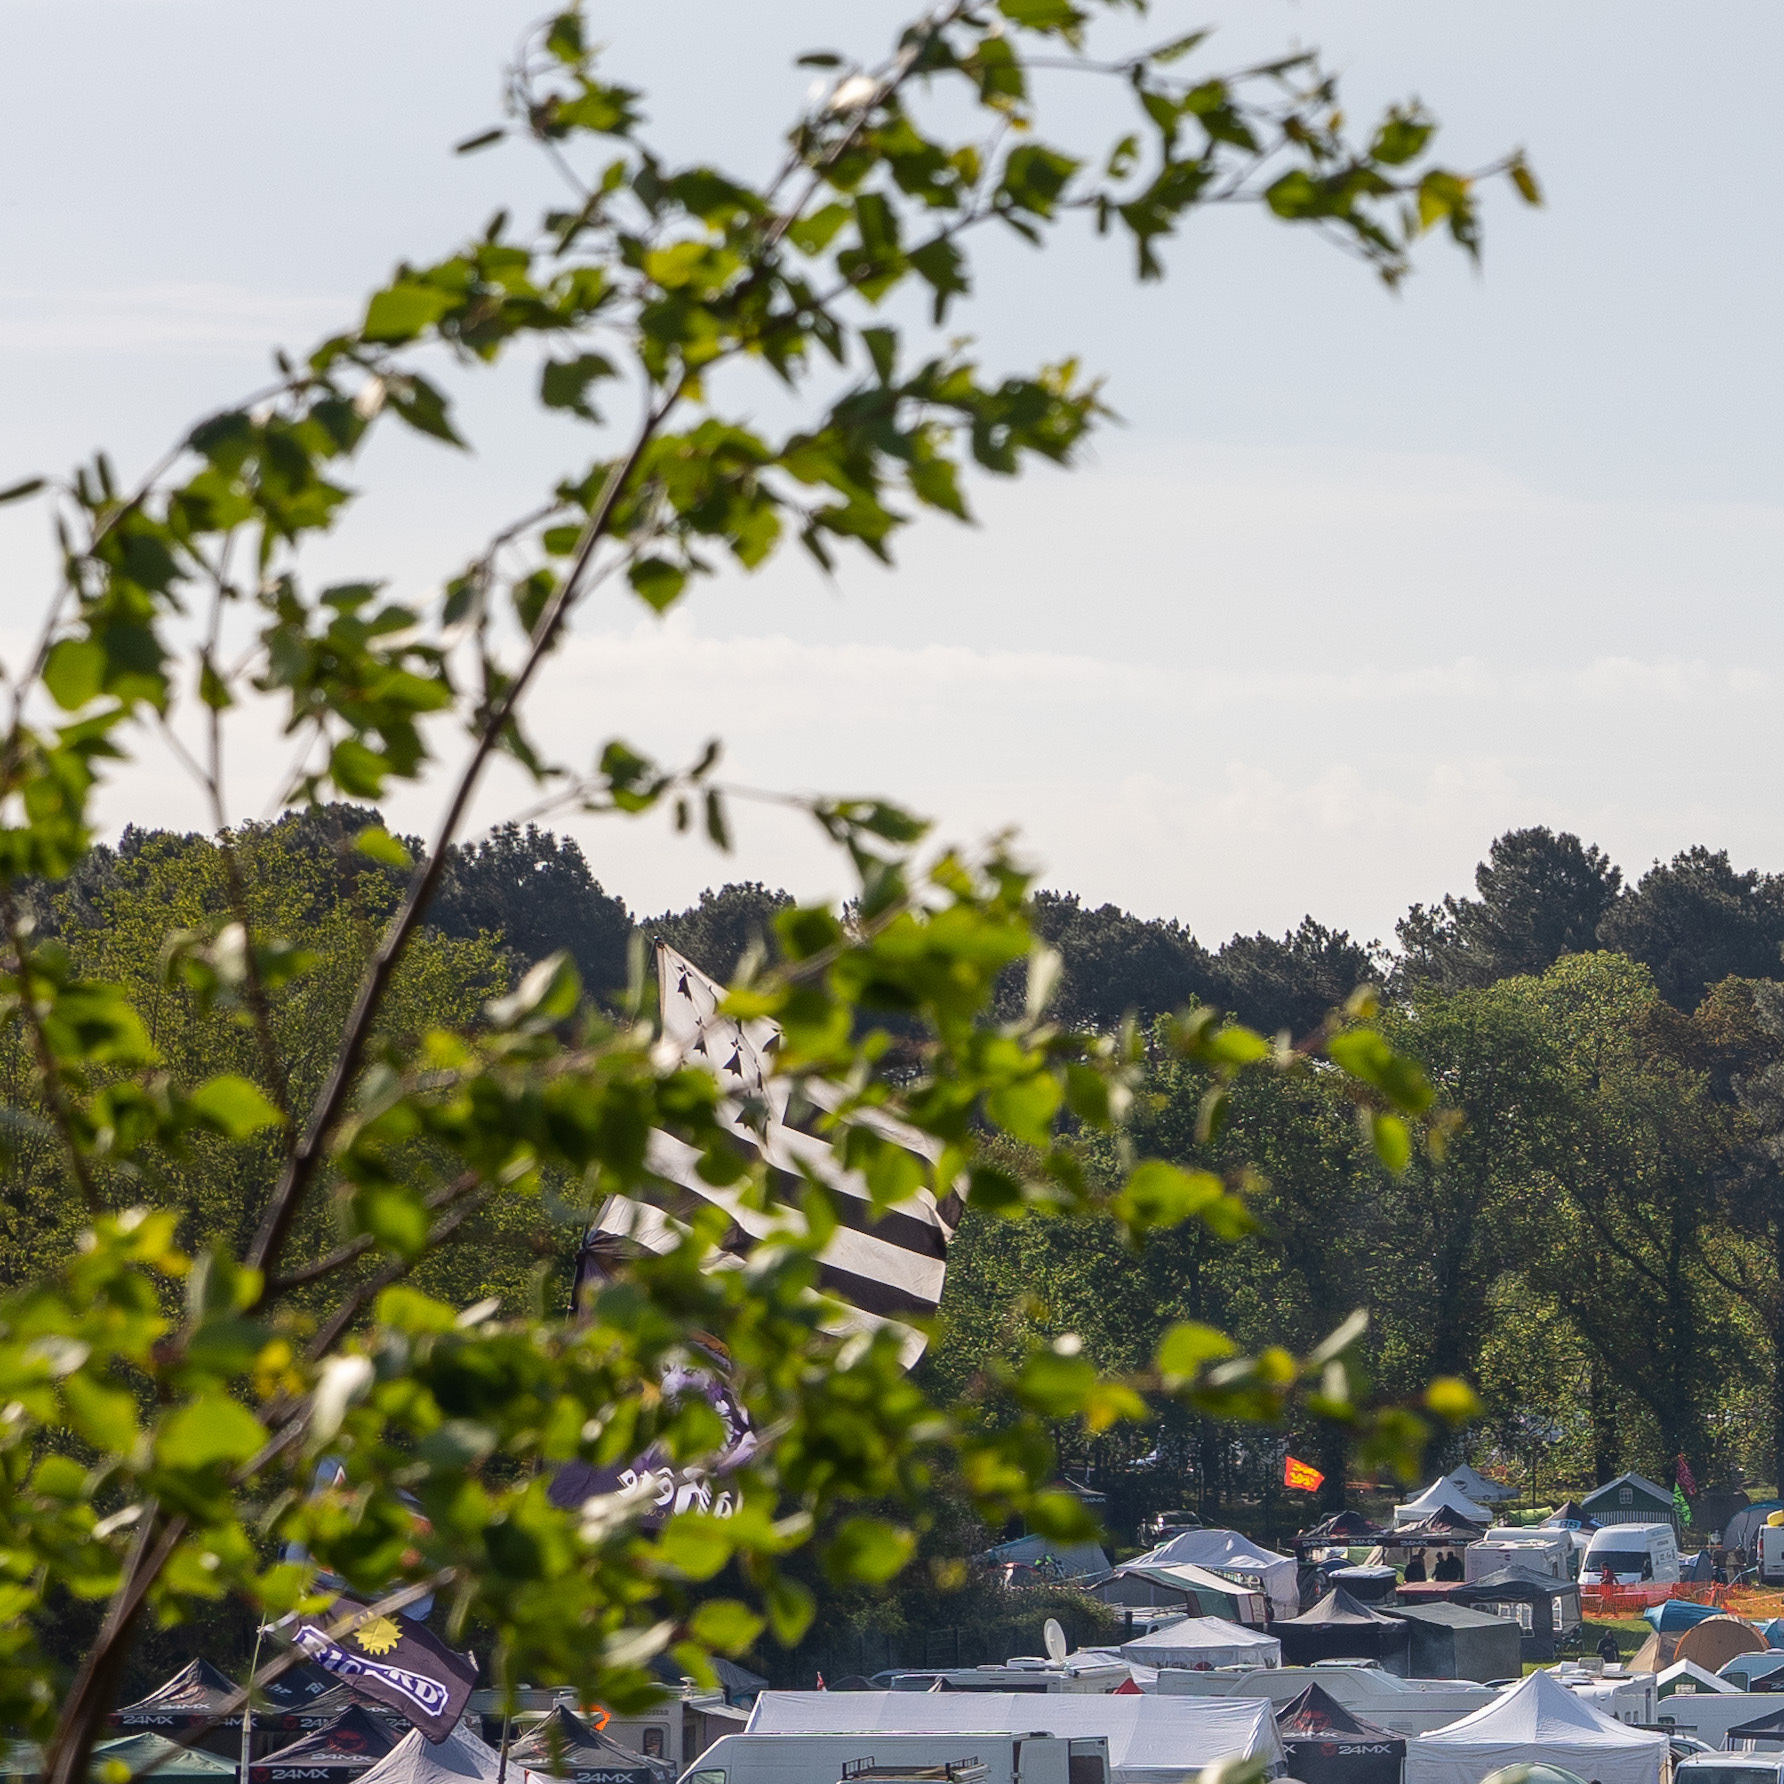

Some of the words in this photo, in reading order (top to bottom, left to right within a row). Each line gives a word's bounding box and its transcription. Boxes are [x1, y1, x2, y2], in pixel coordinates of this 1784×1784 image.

[122, 1714, 175, 1727] 24MX
[1338, 1744, 1393, 1755] 24MX
[271, 1767, 330, 1781] 24MX
[577, 1772, 635, 1784] 24MX
